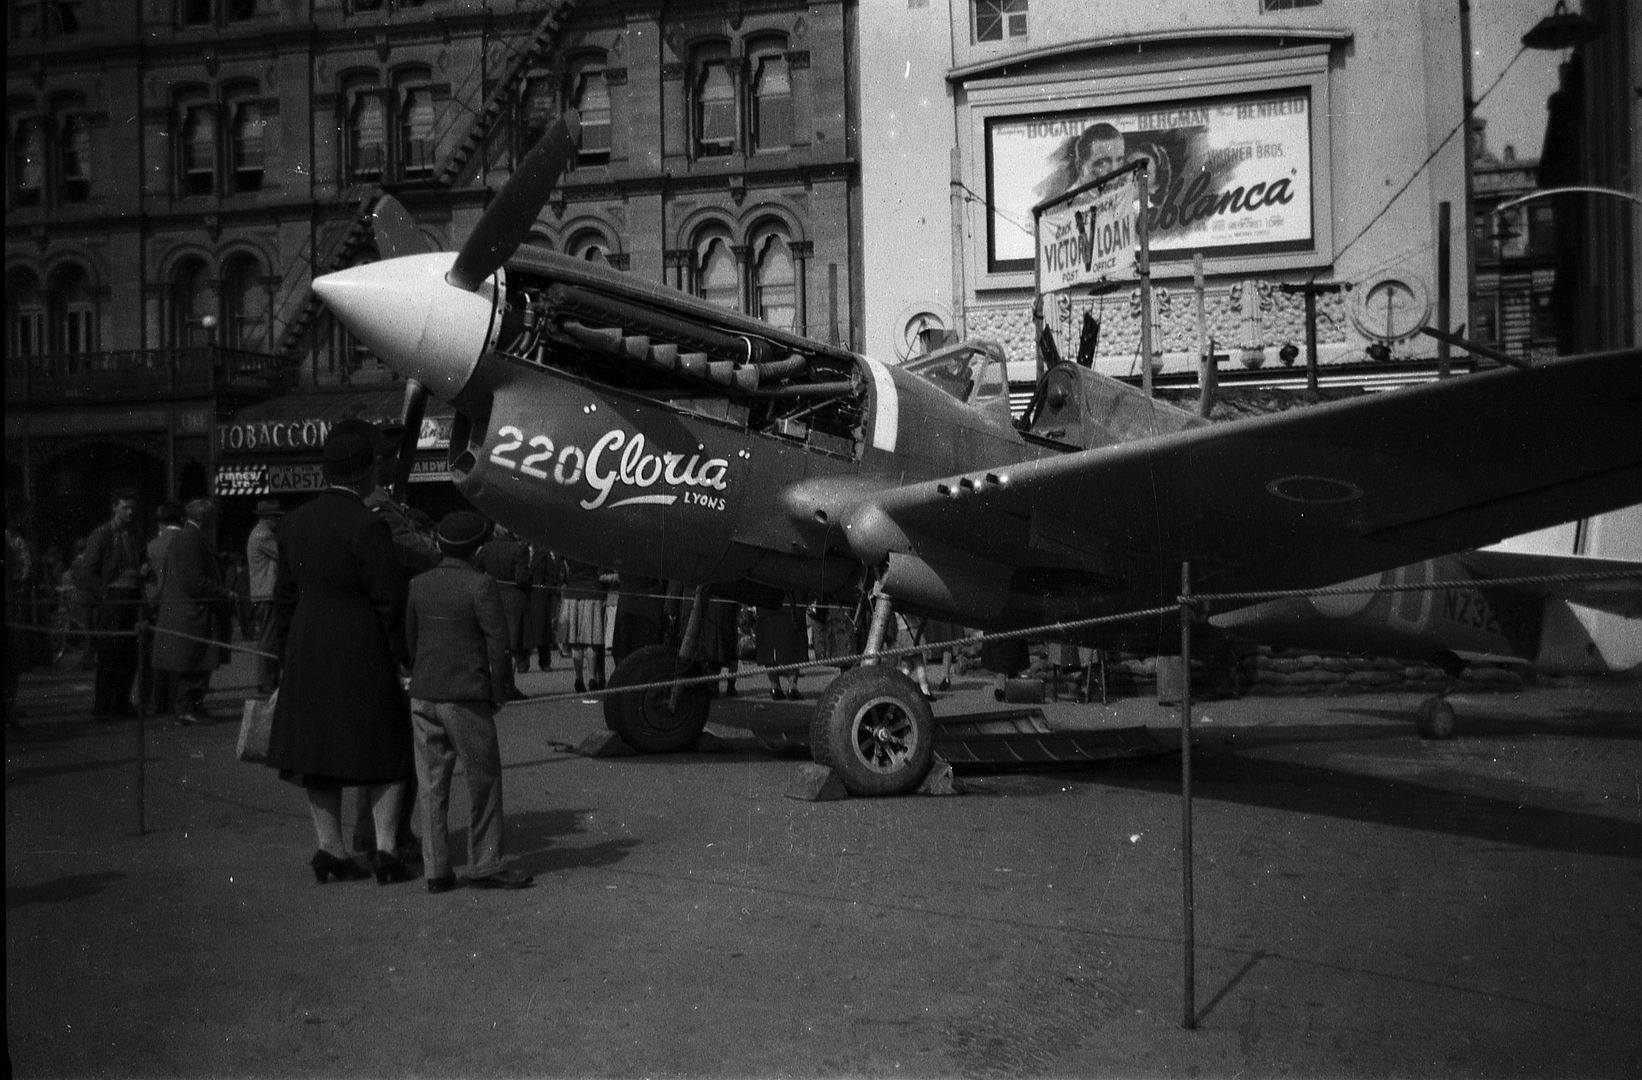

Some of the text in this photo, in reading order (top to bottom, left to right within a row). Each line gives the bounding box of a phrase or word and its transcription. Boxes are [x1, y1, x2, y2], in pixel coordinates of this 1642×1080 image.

[1138, 108, 1209, 131] BERGMAN
[1237, 97, 1305, 120] HENREID
[1027, 120, 1085, 139] BOGART
[1207, 145, 1252, 164] WARNER
[1097, 215, 1131, 258] LOAN
[1062, 257, 1116, 282] POST OFFICE
[489, 425, 584, 485] 220
[683, 491, 727, 511] LYONS
